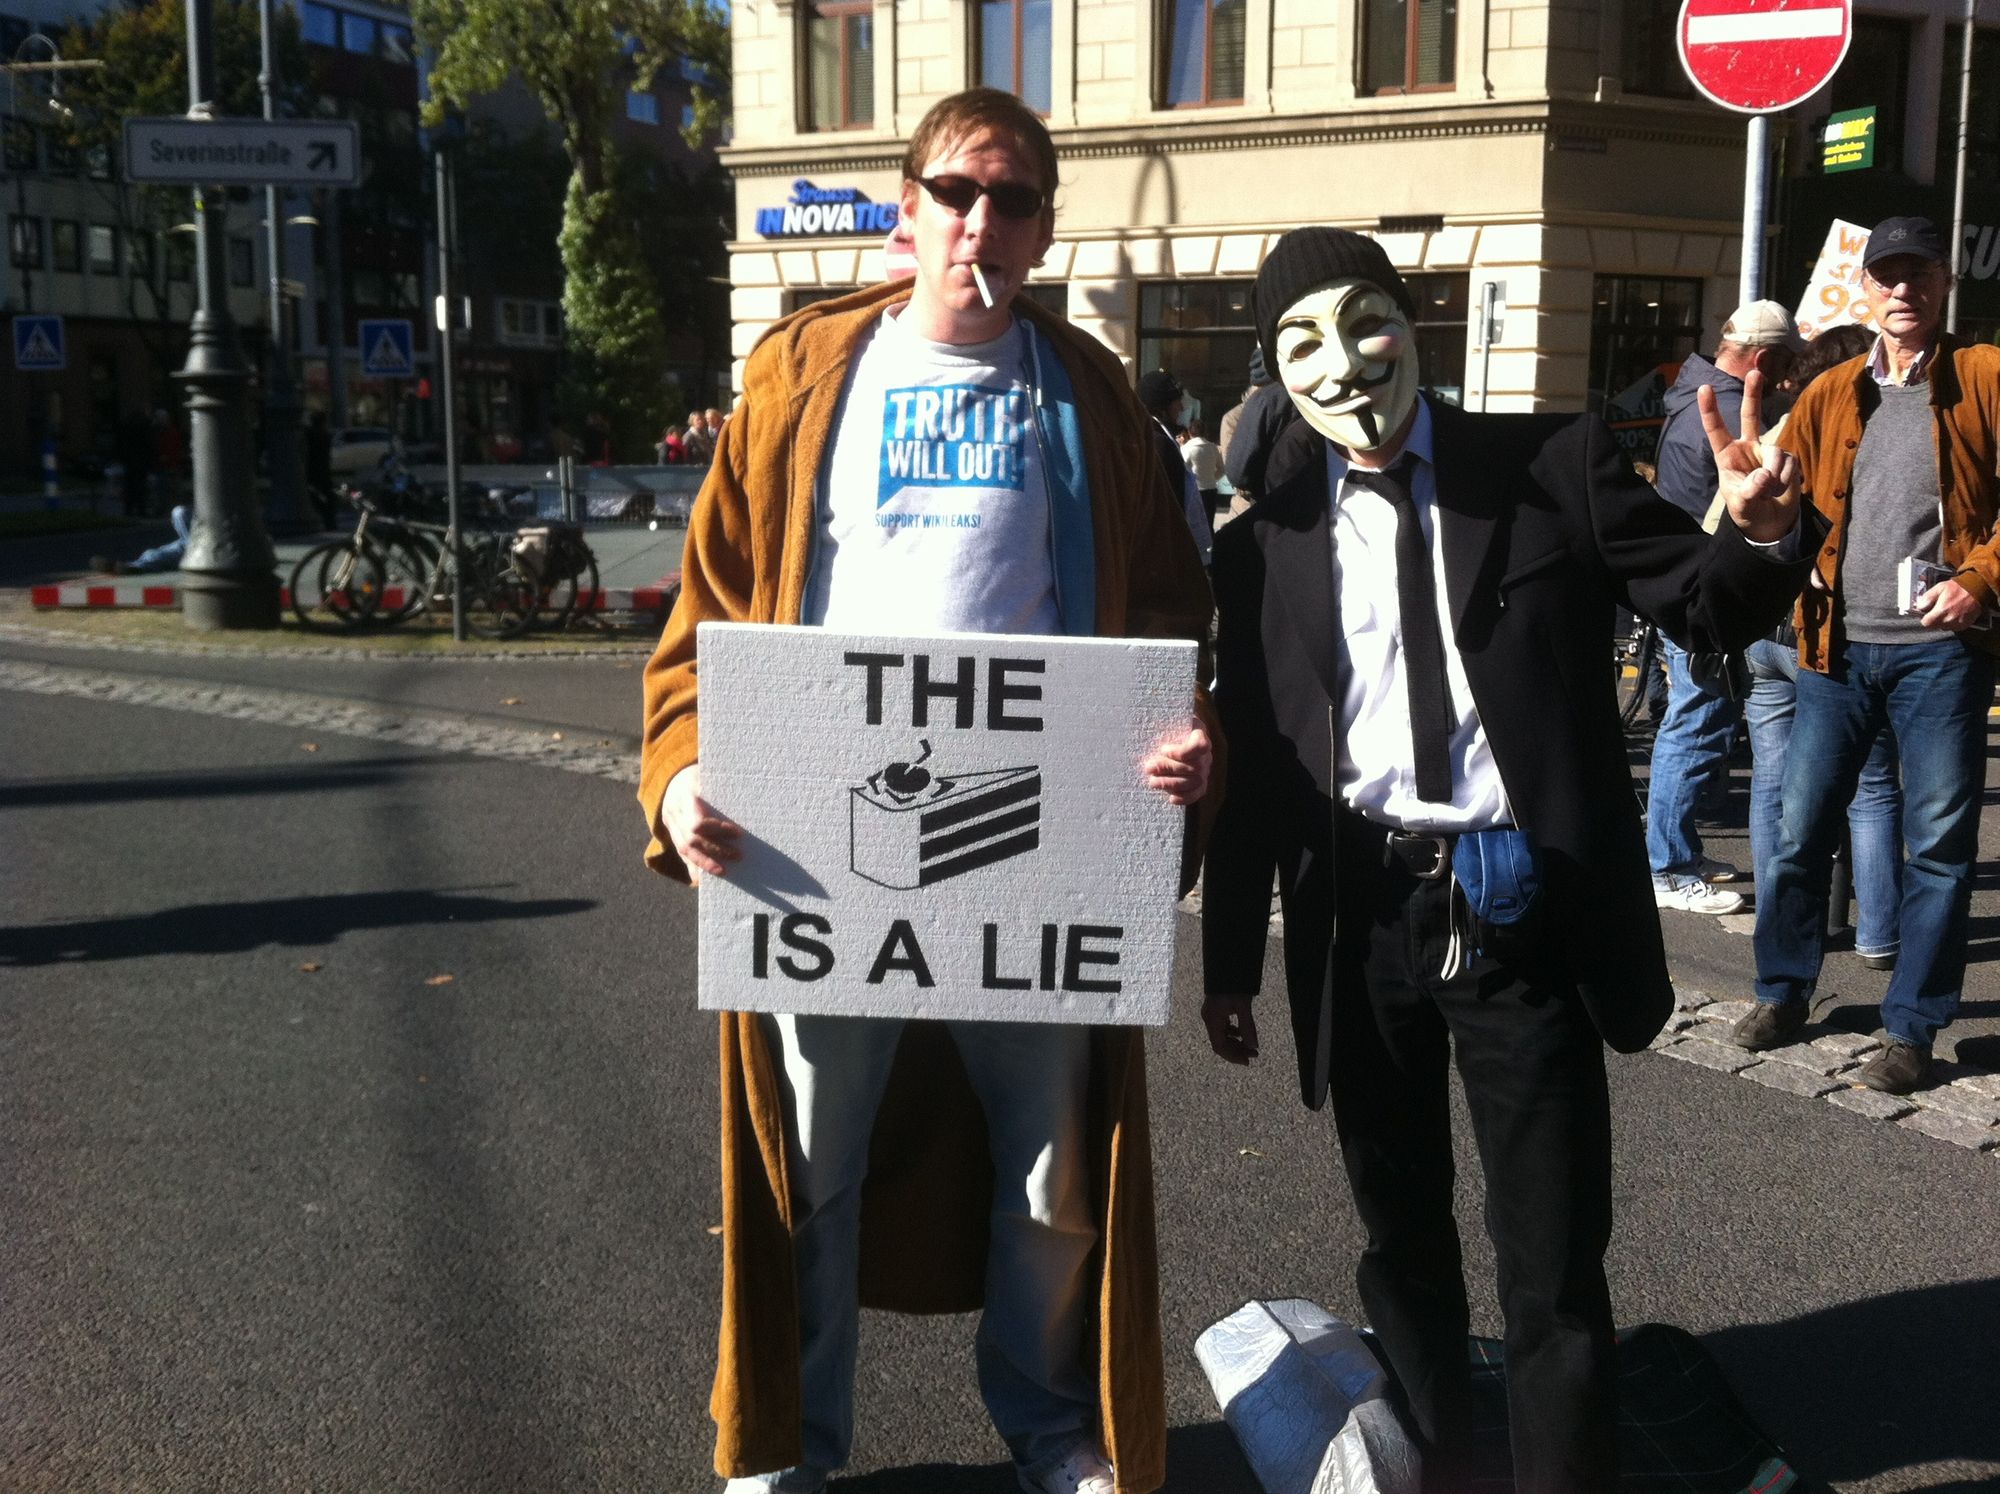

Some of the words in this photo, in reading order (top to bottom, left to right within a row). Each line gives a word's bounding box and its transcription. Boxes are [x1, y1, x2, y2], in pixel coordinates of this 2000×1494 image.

[150, 138, 292, 166] Severinstraße
[890, 388, 1021, 443] TRUTH
[887, 439, 951, 481] WILL
[957, 441, 1018, 482] OUT!
[874, 513, 920, 528] SUPPORT
[844, 652, 1046, 732] THE
[752, 911, 835, 982] IS
[866, 919, 936, 988] A
[981, 923, 1124, 994] LIE
